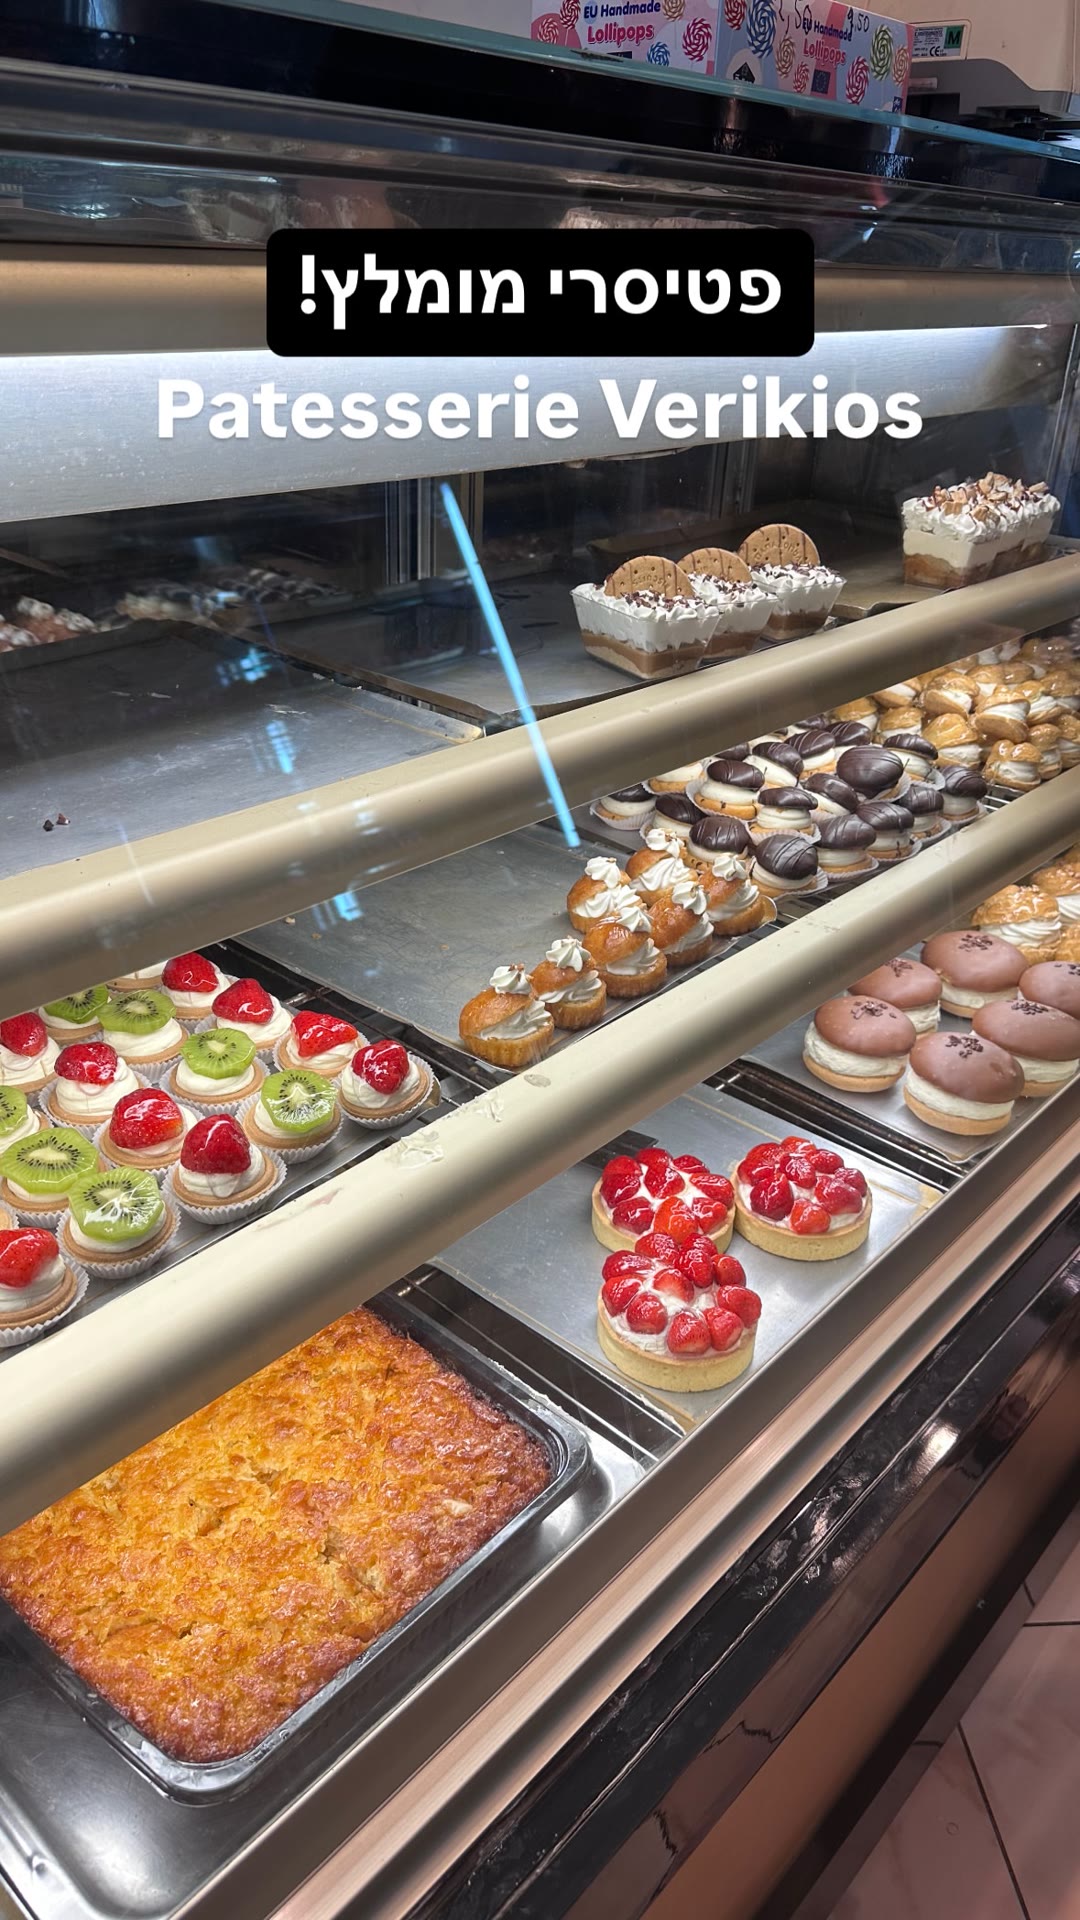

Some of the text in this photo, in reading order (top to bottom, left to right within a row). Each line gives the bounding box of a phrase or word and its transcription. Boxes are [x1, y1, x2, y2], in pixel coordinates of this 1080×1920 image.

[583, 0, 661, 19] EU Handmade
[587, 22, 655, 47] Lollipops
[948, 31, 961, 45] M
[803, 38, 847, 65] Lollipops
